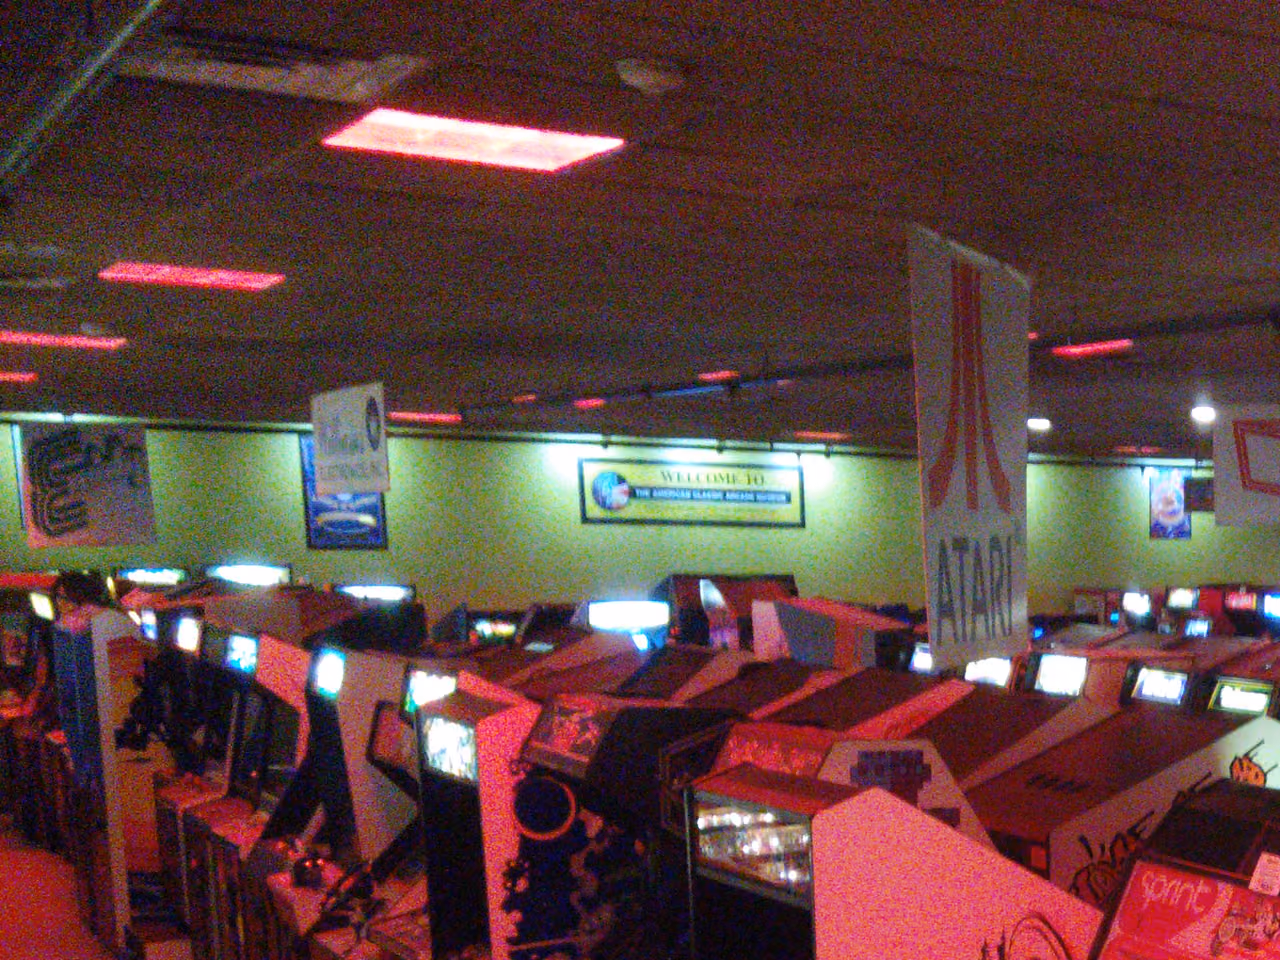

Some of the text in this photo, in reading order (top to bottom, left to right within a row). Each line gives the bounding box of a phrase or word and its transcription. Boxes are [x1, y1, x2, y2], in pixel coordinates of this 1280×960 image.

[661, 469, 766, 486] WELCOME TO
[936, 535, 1012, 645] ATARI
